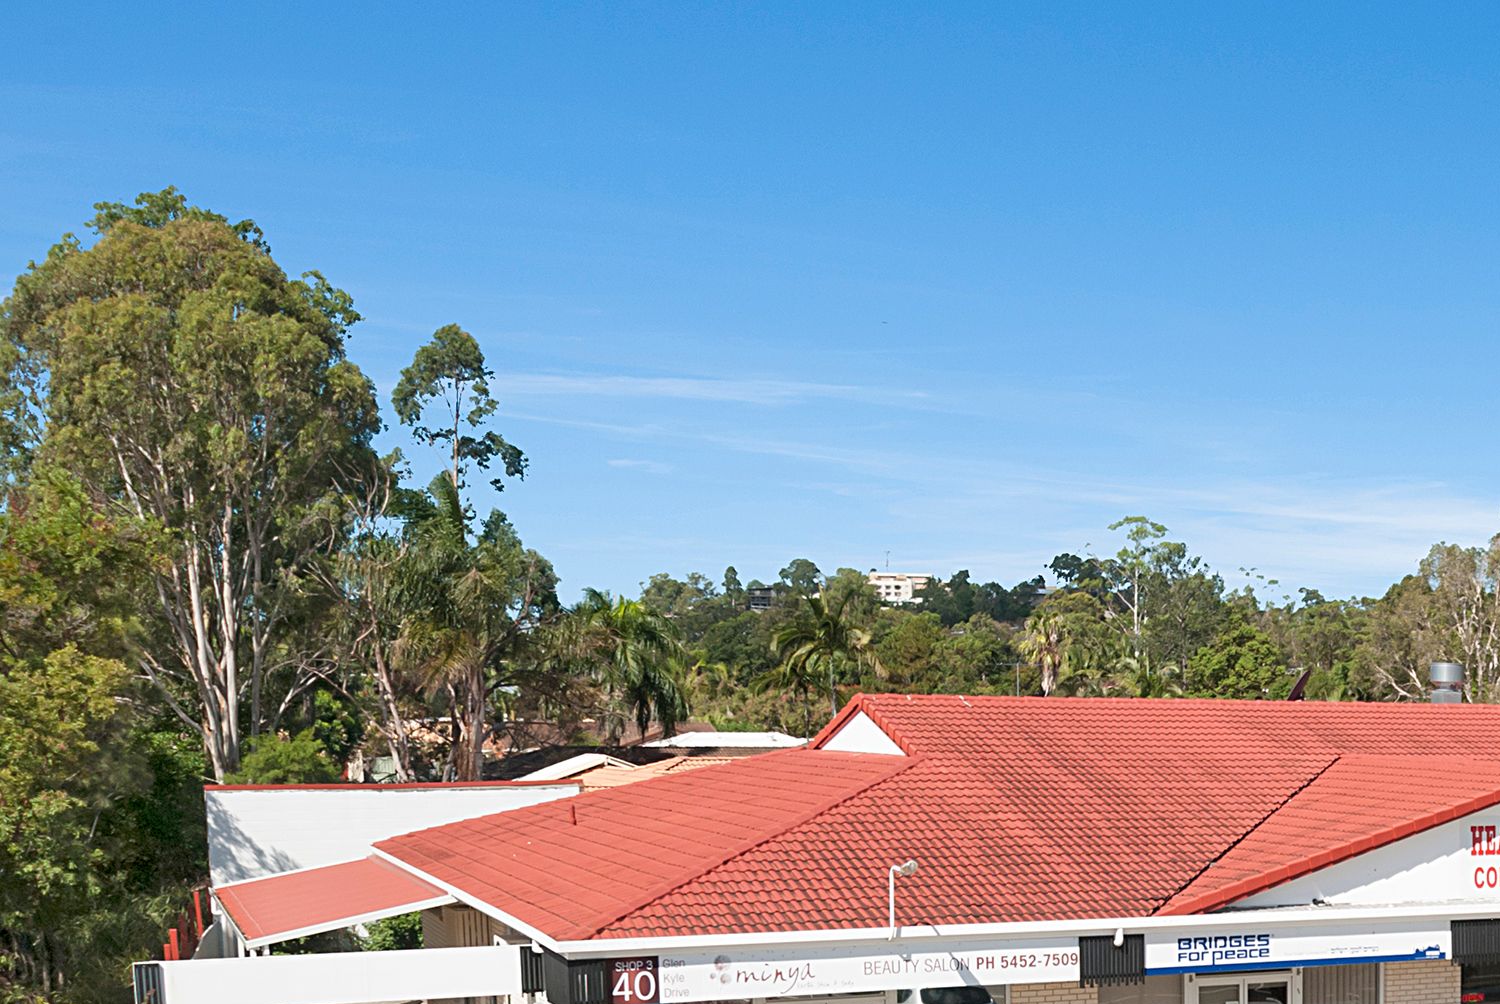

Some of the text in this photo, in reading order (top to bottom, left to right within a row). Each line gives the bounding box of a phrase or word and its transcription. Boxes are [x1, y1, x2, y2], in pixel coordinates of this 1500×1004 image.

[1178, 934, 1270, 950] BRIDGES
[662, 959, 686, 968] Glen
[864, 952, 1079, 976] BEAUTY SALON PH 5452-7509
[1212, 947, 1270, 966] peace
[615, 960, 653, 972] SHOP 3
[612, 970, 656, 1001] 40
[663, 974, 685, 985] Kyle
[736, 963, 816, 994] minya
[664, 988, 689, 998] Drive
